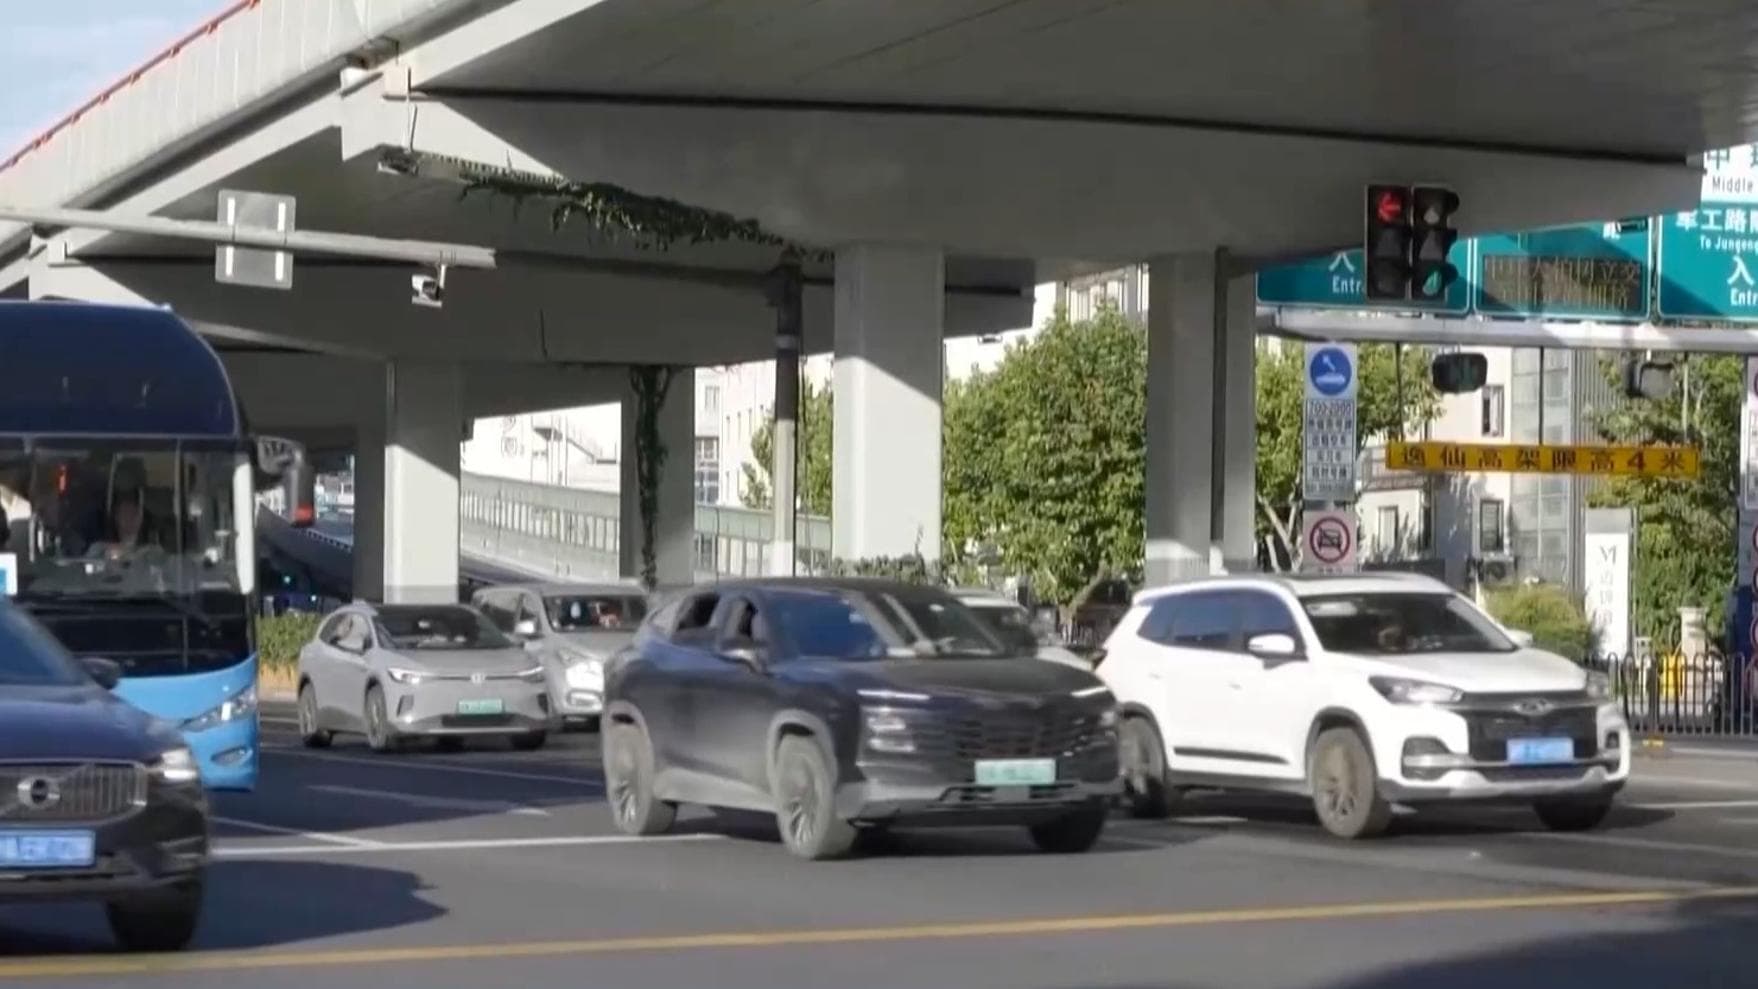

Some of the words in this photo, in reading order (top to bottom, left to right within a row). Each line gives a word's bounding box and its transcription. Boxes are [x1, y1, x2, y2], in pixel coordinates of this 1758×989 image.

[1706, 147, 1758, 171] 中
[1712, 176, 1753, 193] Middle
[1700, 235, 1712, 250] To
[1727, 255, 1755, 285] 入
[1402, 445, 1686, 473] 逸仙高架限高4米
